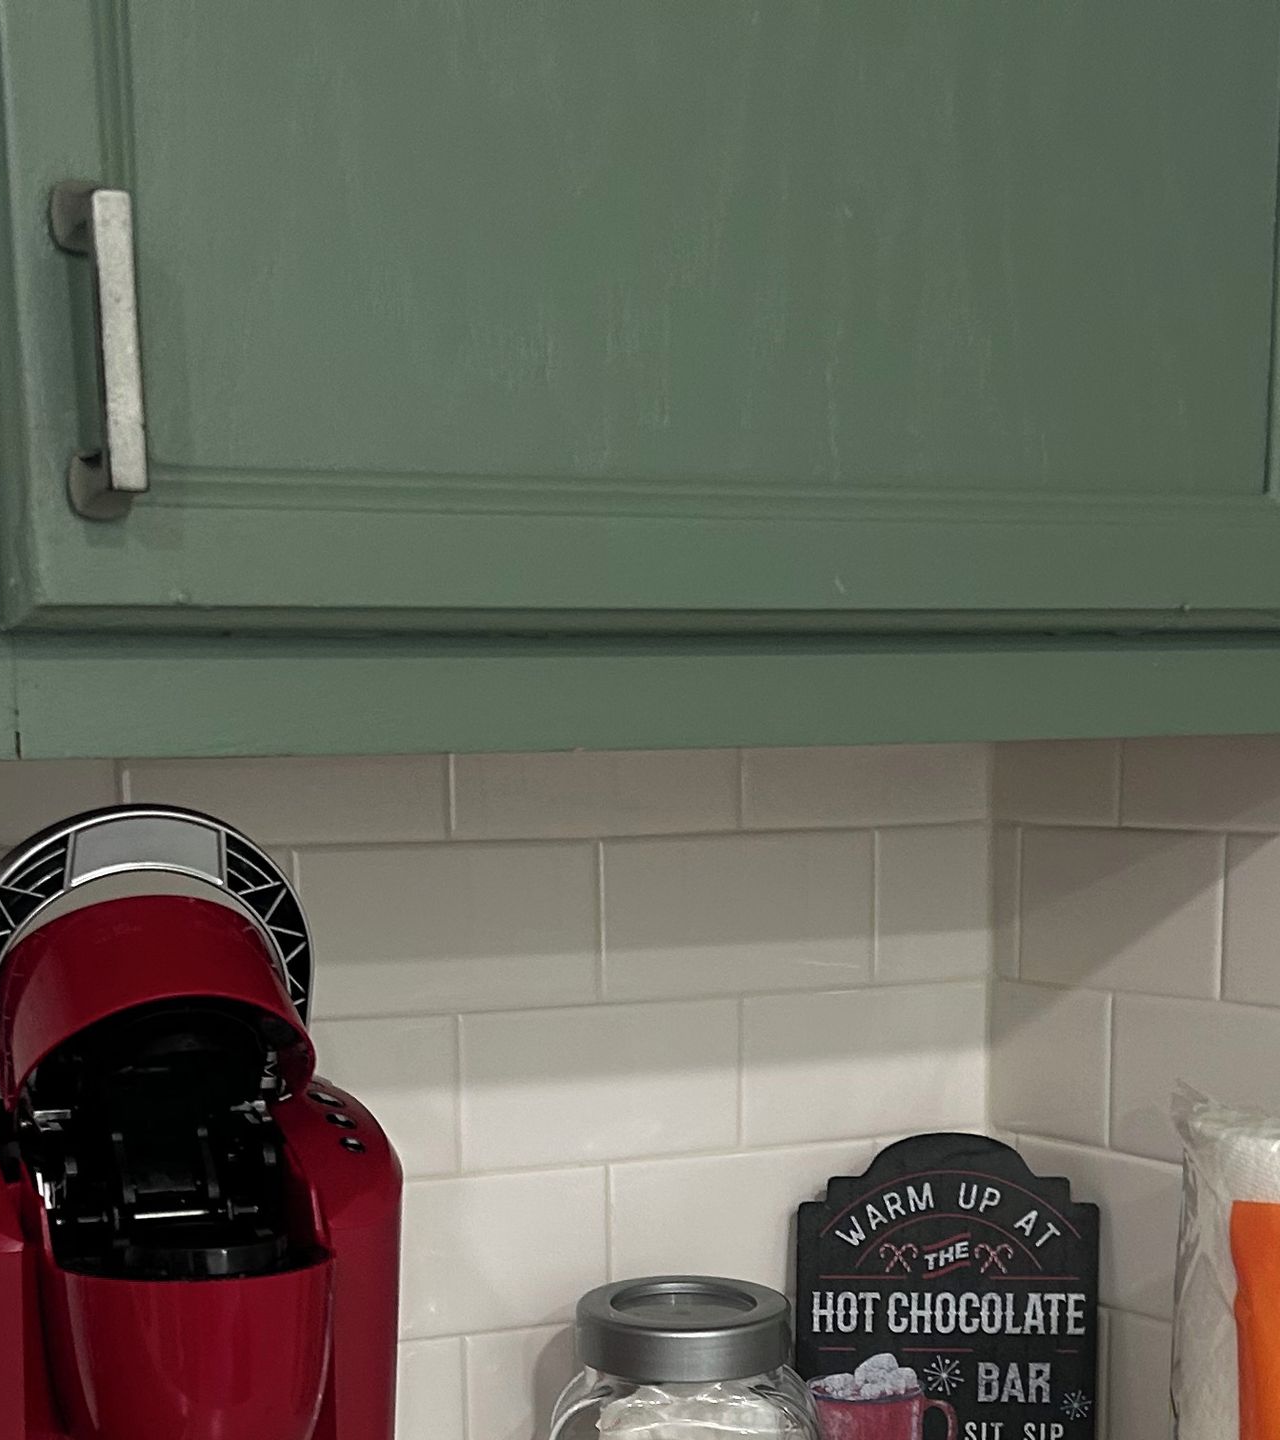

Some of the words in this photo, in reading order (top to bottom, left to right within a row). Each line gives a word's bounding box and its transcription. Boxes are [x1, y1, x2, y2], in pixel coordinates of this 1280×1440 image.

[834, 1182, 936, 1248] WARM
[958, 1182, 1002, 1213] UP
[1013, 1209, 1062, 1248] AT
[923, 1240, 970, 1272] THE
[811, 1291, 881, 1334] HOT
[886, 1291, 1087, 1335] CHOCOLATE
[976, 1361, 1051, 1404] BAR
